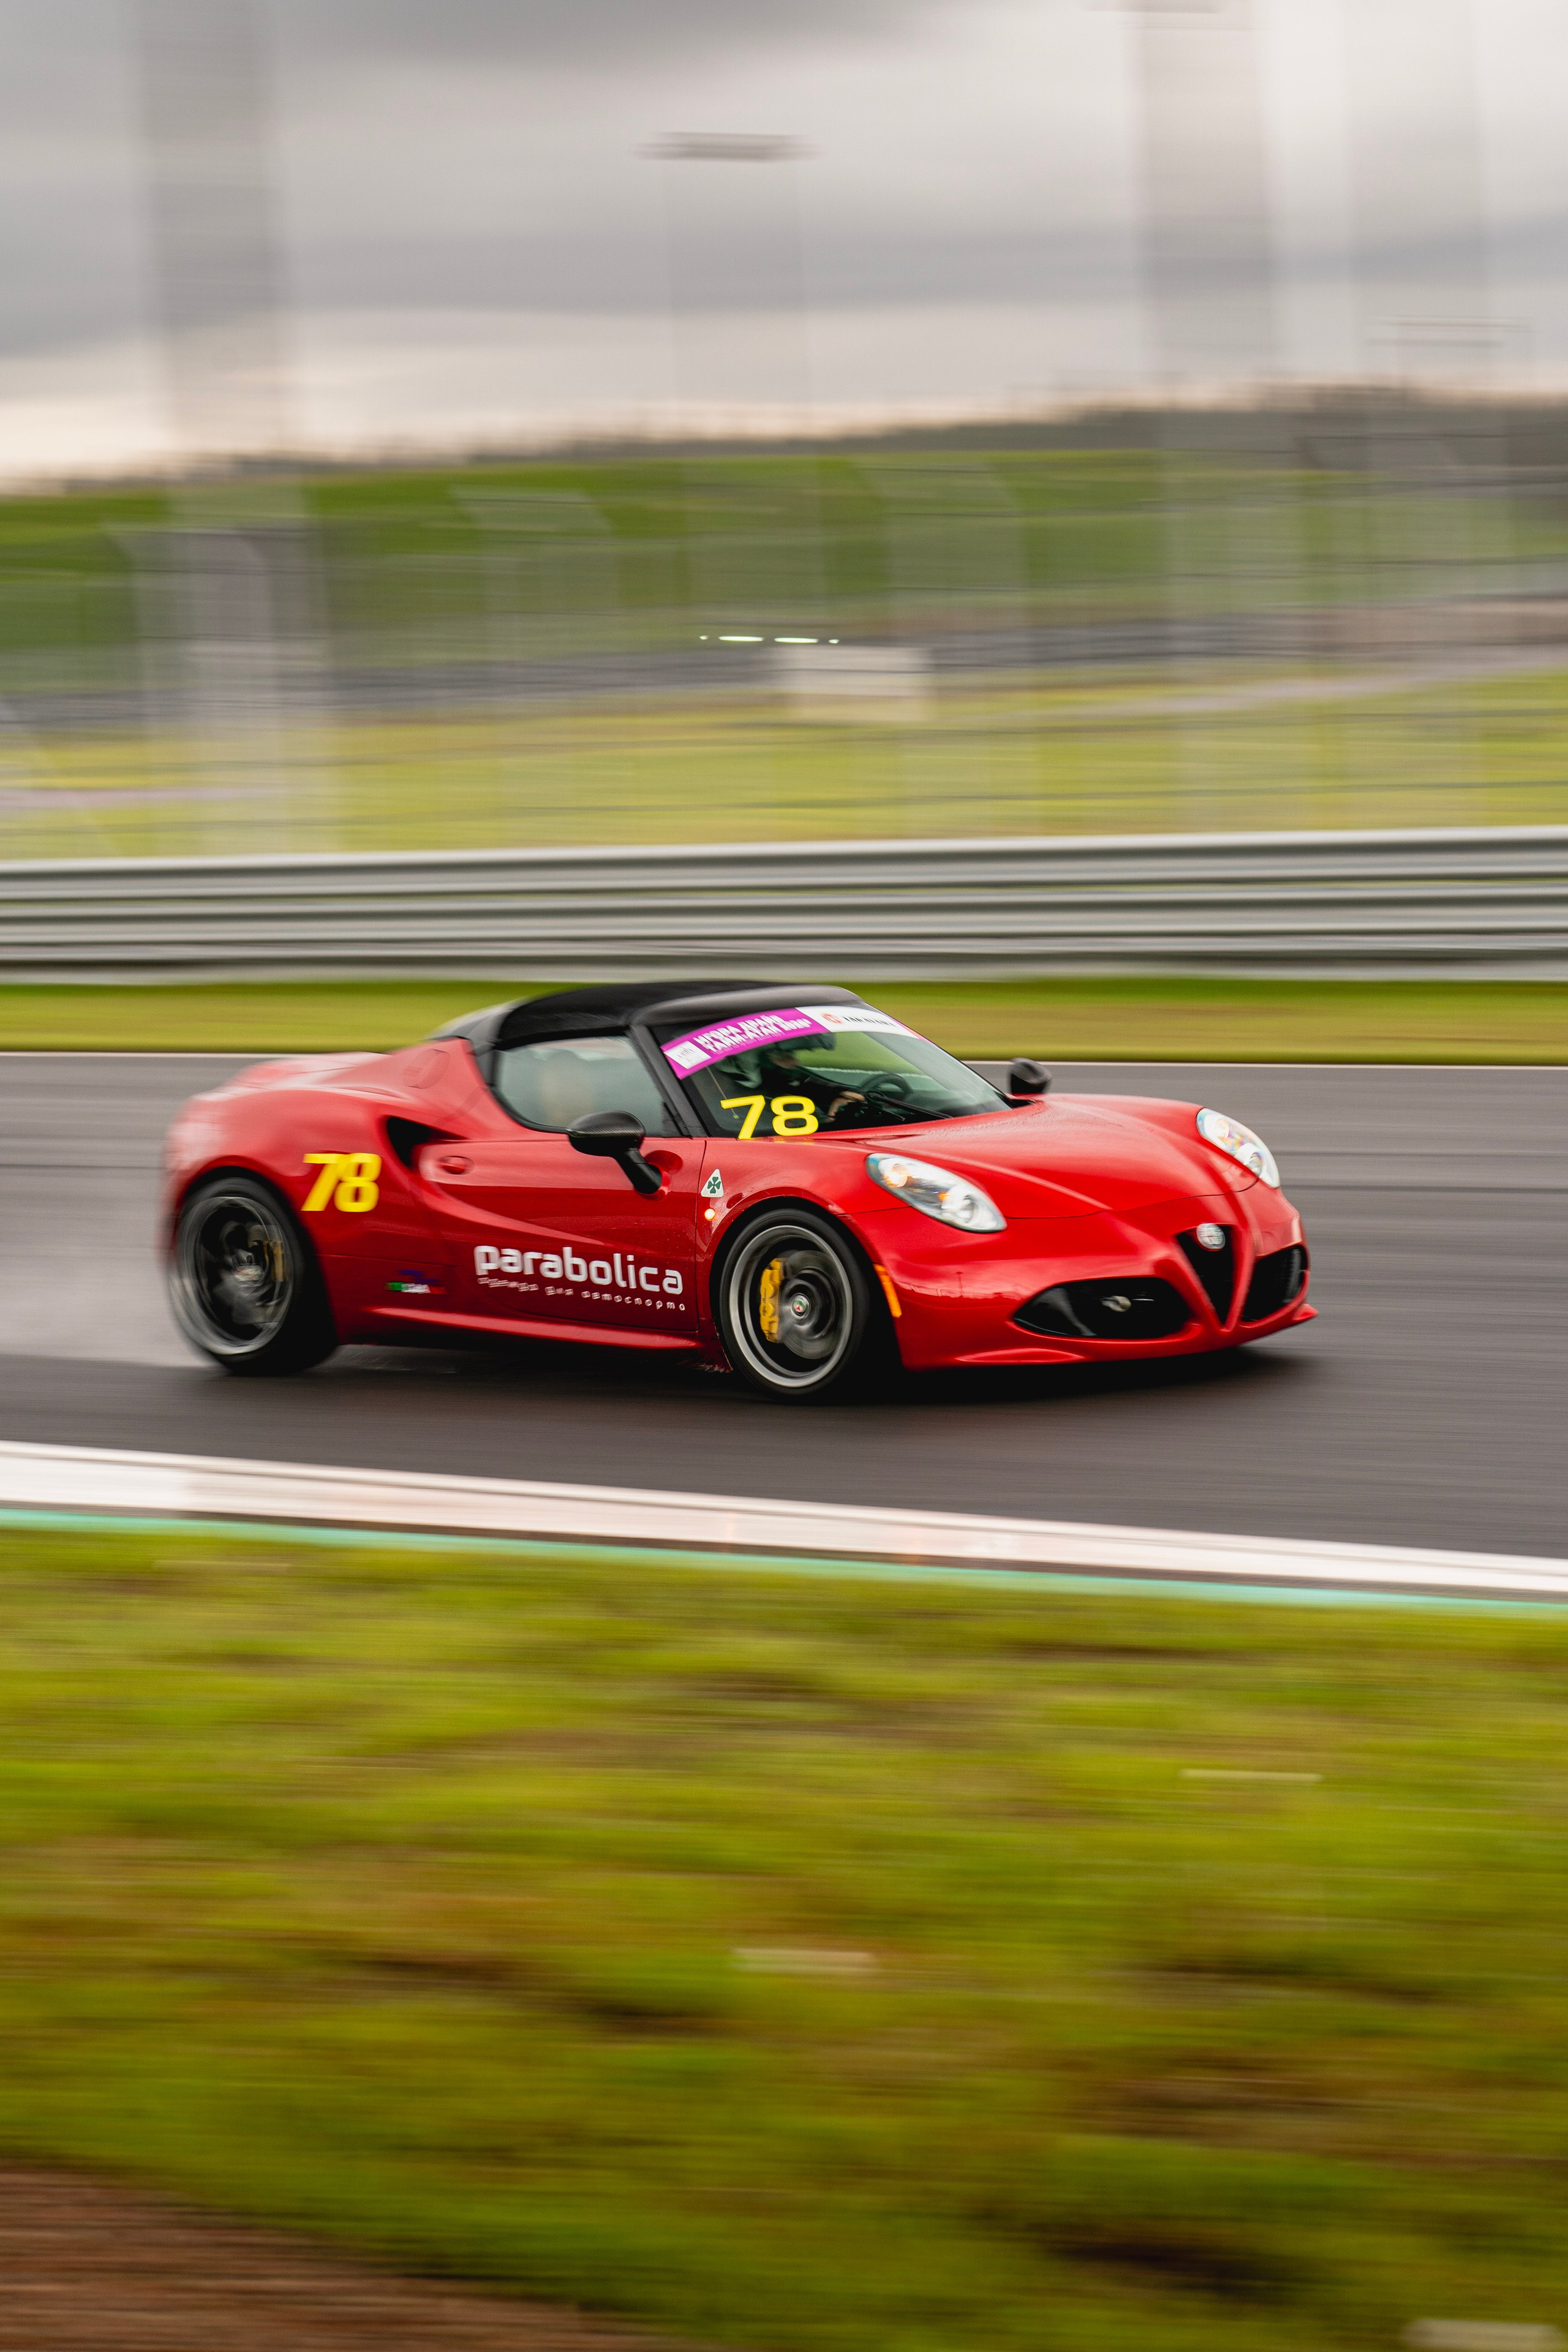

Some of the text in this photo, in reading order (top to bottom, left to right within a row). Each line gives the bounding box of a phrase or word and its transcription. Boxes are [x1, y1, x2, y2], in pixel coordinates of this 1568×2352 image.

[720, 1095, 819, 1140] 78
[300, 1152, 382, 1213] 78
[473, 1245, 683, 1295] parabolica
